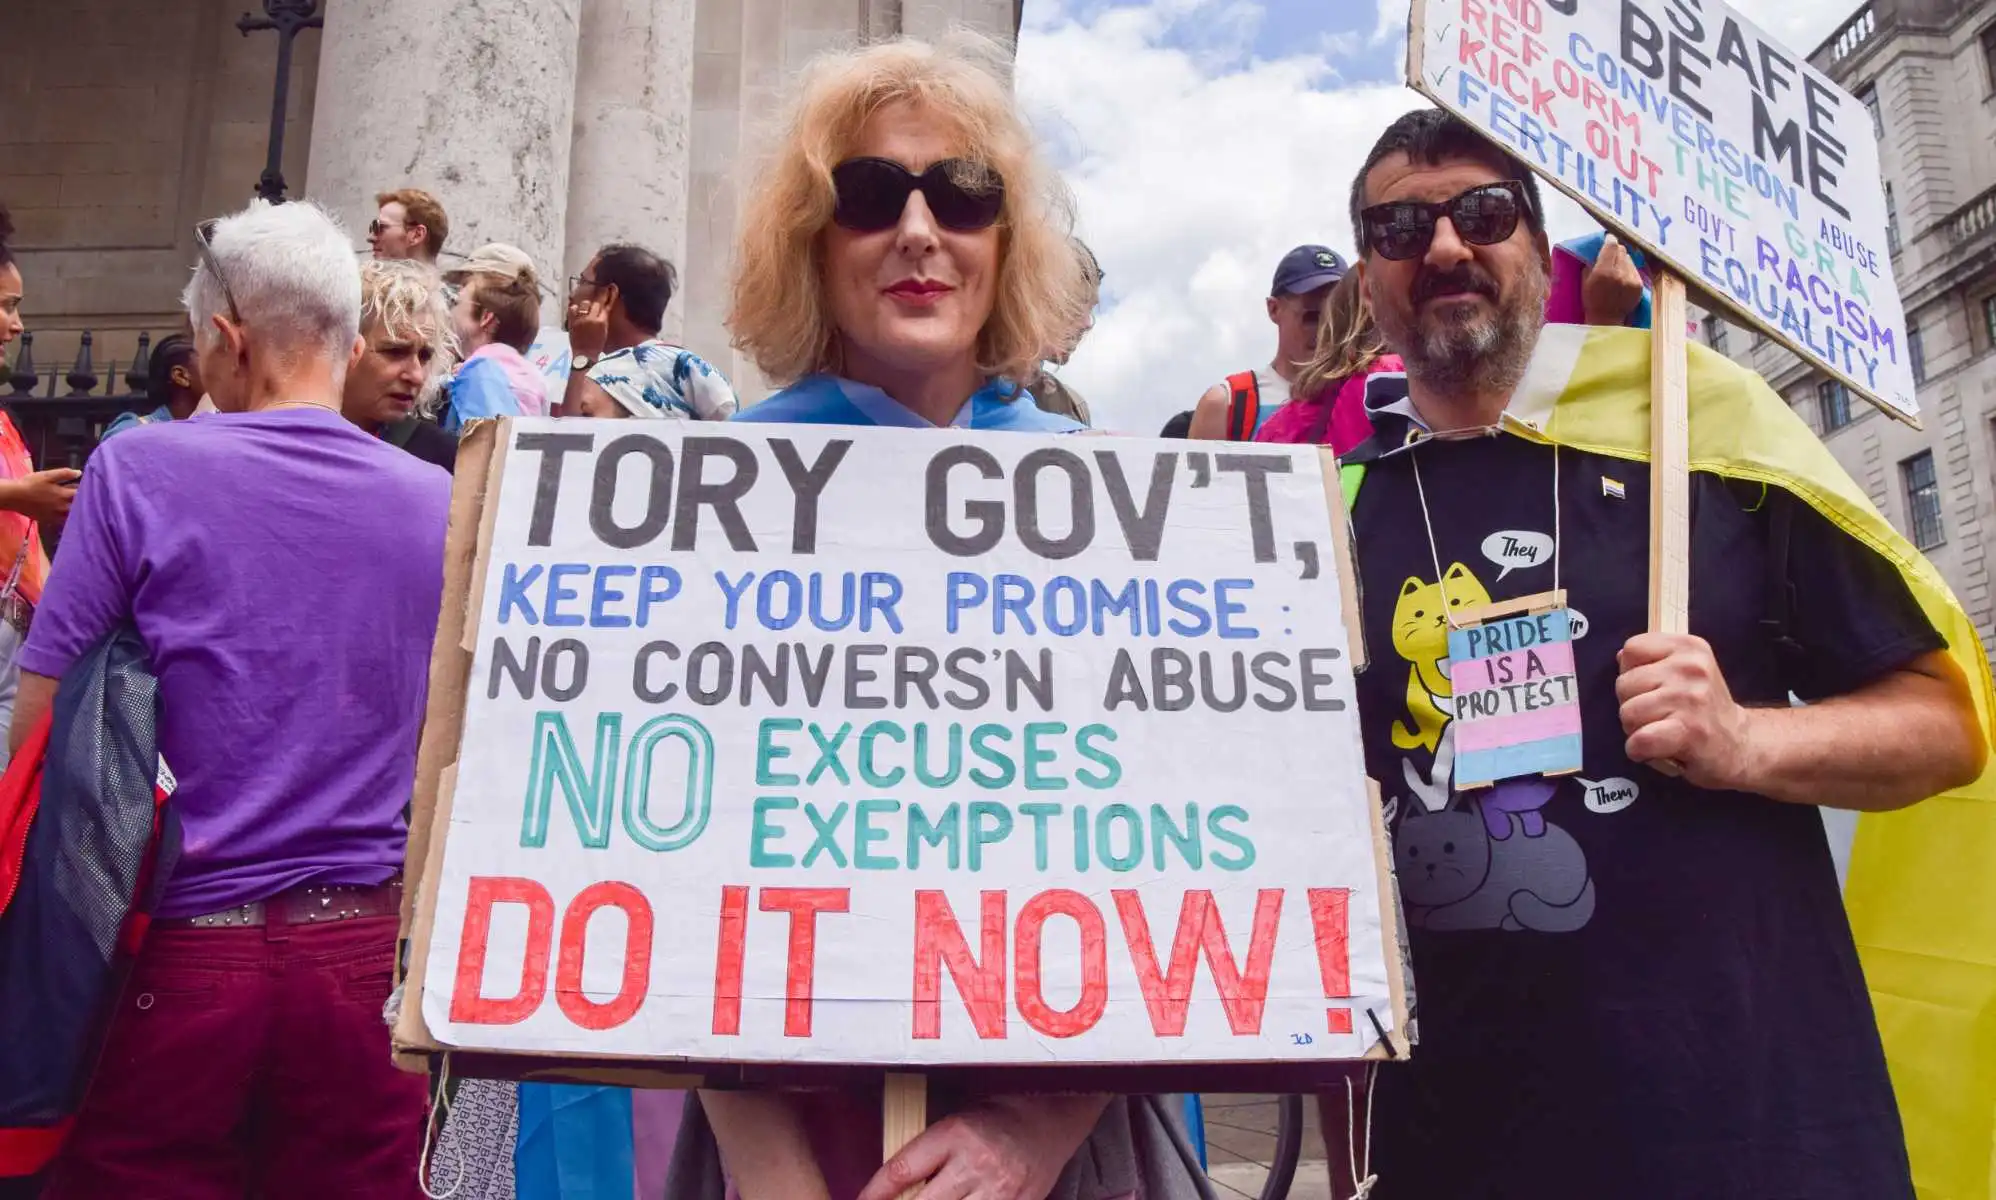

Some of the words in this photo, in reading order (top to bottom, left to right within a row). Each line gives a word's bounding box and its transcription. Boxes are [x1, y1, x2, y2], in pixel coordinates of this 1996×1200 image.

[1461, 0, 1641, 147] REFORM
[1667, 134, 1751, 221] THE
[1569, 32, 1798, 220] CONVERSION
[1820, 216, 1880, 279] ABUSE
[1620, 0, 1713, 124] BE
[1751, 89, 1852, 222] ME
[1457, 70, 1673, 246] FERTILITY
[1699, 238, 1879, 389] EQUALITY
[1458, 28, 1559, 129] KICK
[1585, 119, 1664, 198] OUT
[1756, 234, 1897, 365] RACISM
[515, 432, 853, 554] TORY
[924, 443, 1321, 581] GOV'T,
[1501, 536, 1539, 562] They
[497, 562, 682, 628] KEEP
[714, 569, 904, 635] YOUR
[1467, 614, 1553, 658] PRIDE
[487, 635, 590, 702] NO
[632, 640, 1054, 711] CONVERS'N
[1103, 647, 1347, 713] ABUSE
[1455, 675, 1575, 720] PROTEST
[1484, 654, 1514, 685] IS
[1526, 657, 1546, 678] A
[519, 710, 715, 852] NO
[755, 717, 1123, 790] EXCUSES
[749, 796, 1258, 872] EXEMPTIONS
[1590, 785, 1634, 806] Them
[448, 875, 656, 1031] DO
[711, 885, 851, 1038] IT
[911, 887, 1354, 1040] NOW!
